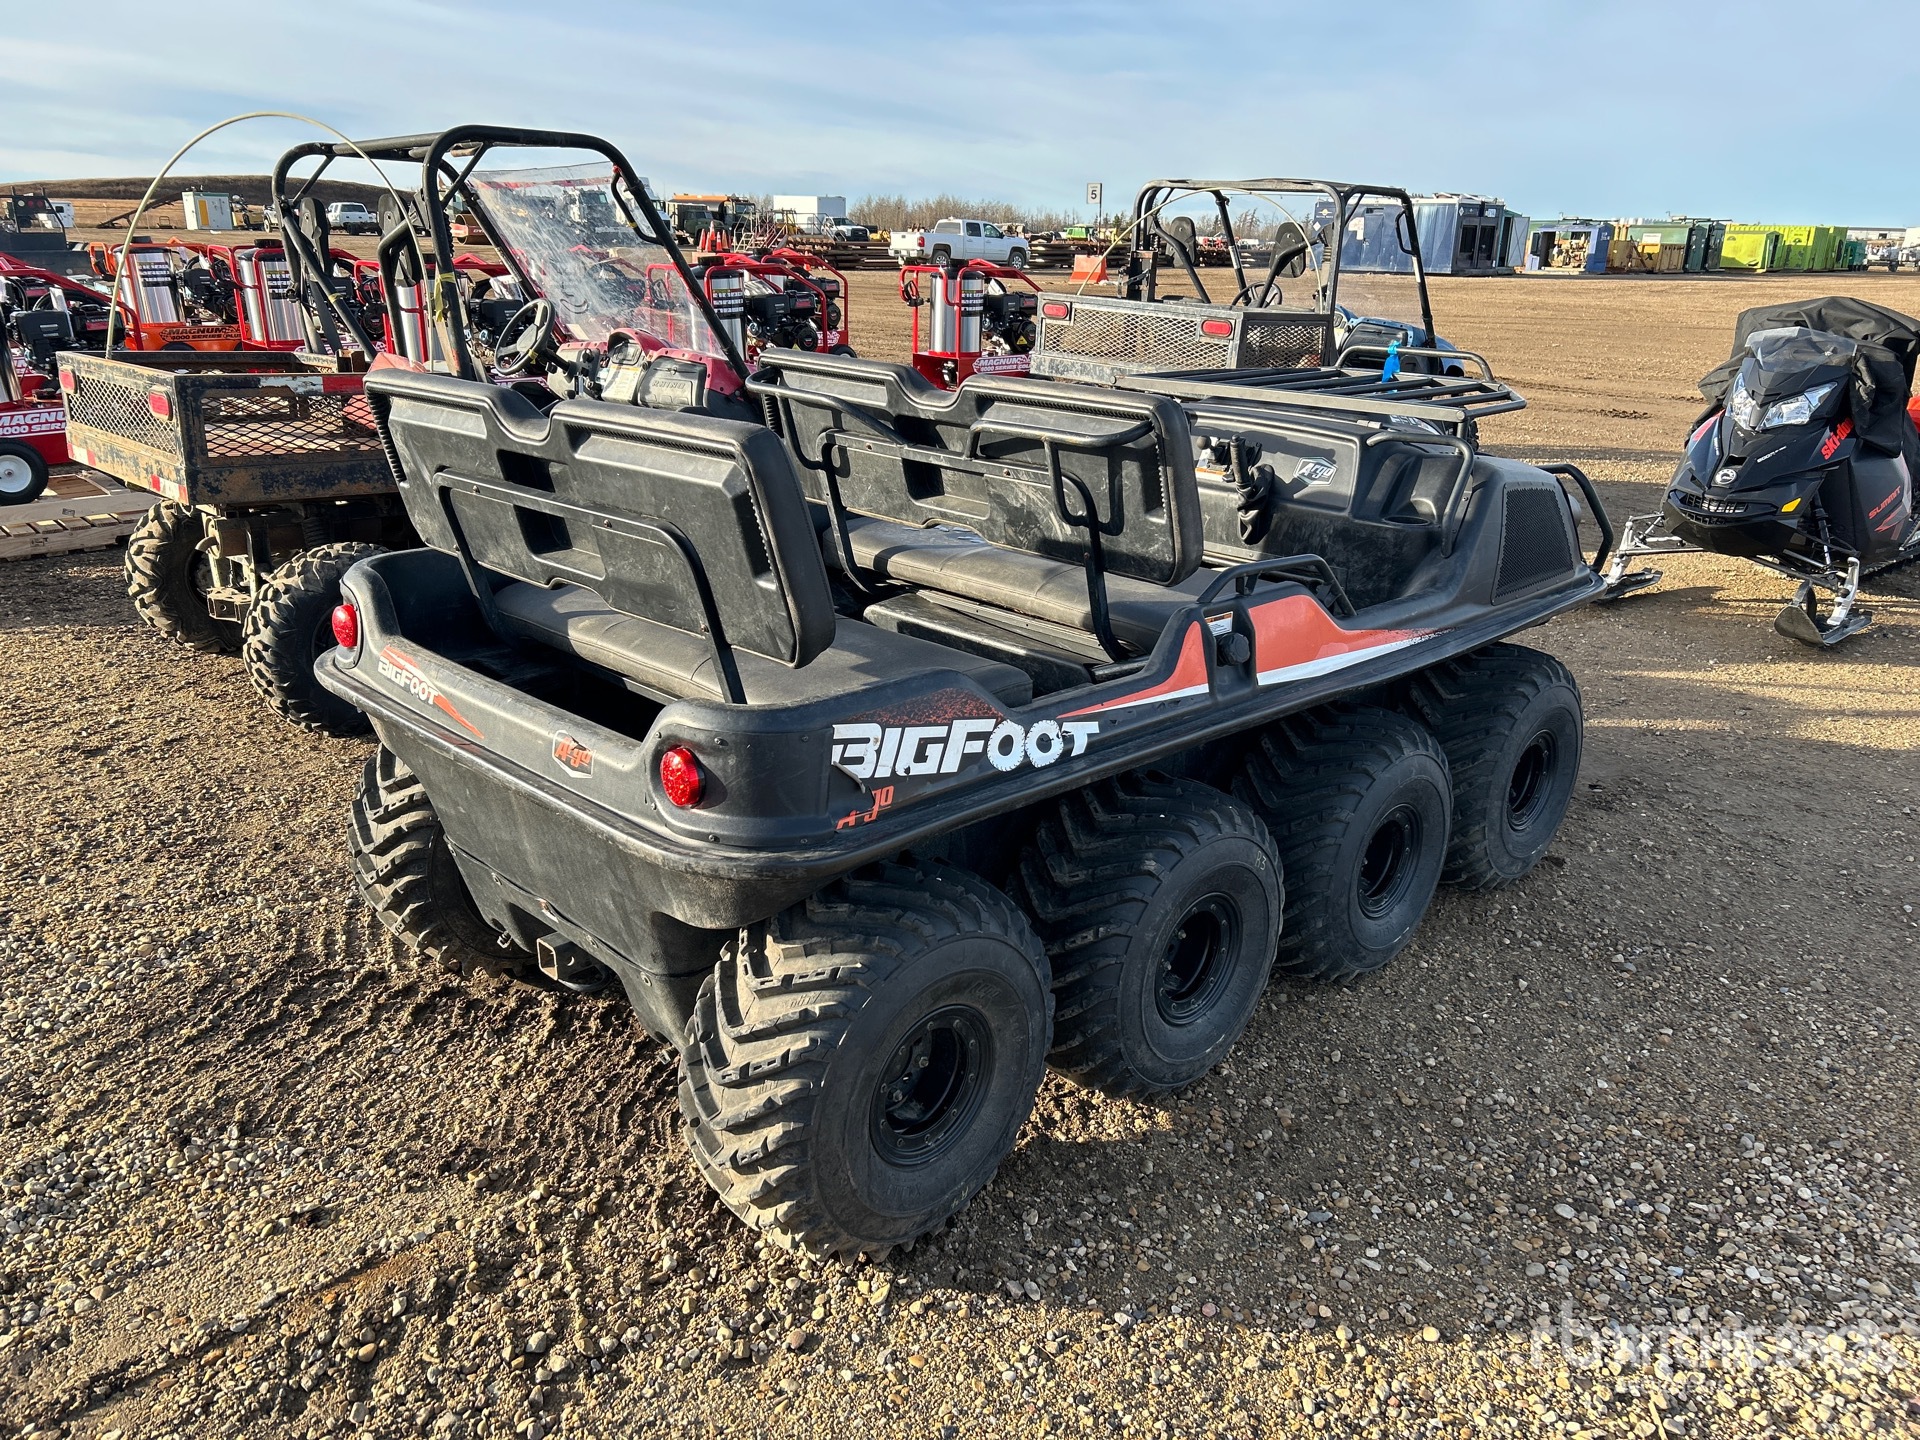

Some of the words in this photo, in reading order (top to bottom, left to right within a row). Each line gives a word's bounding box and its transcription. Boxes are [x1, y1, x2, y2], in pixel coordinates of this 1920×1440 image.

[1090, 189, 1097, 200] 5
[168, 327, 226, 335] MAGNUM
[979, 356, 1020, 366] MAGNUM
[377, 655, 441, 705] BIGFOOT
[831, 718, 1100, 779] BIGFOOT
